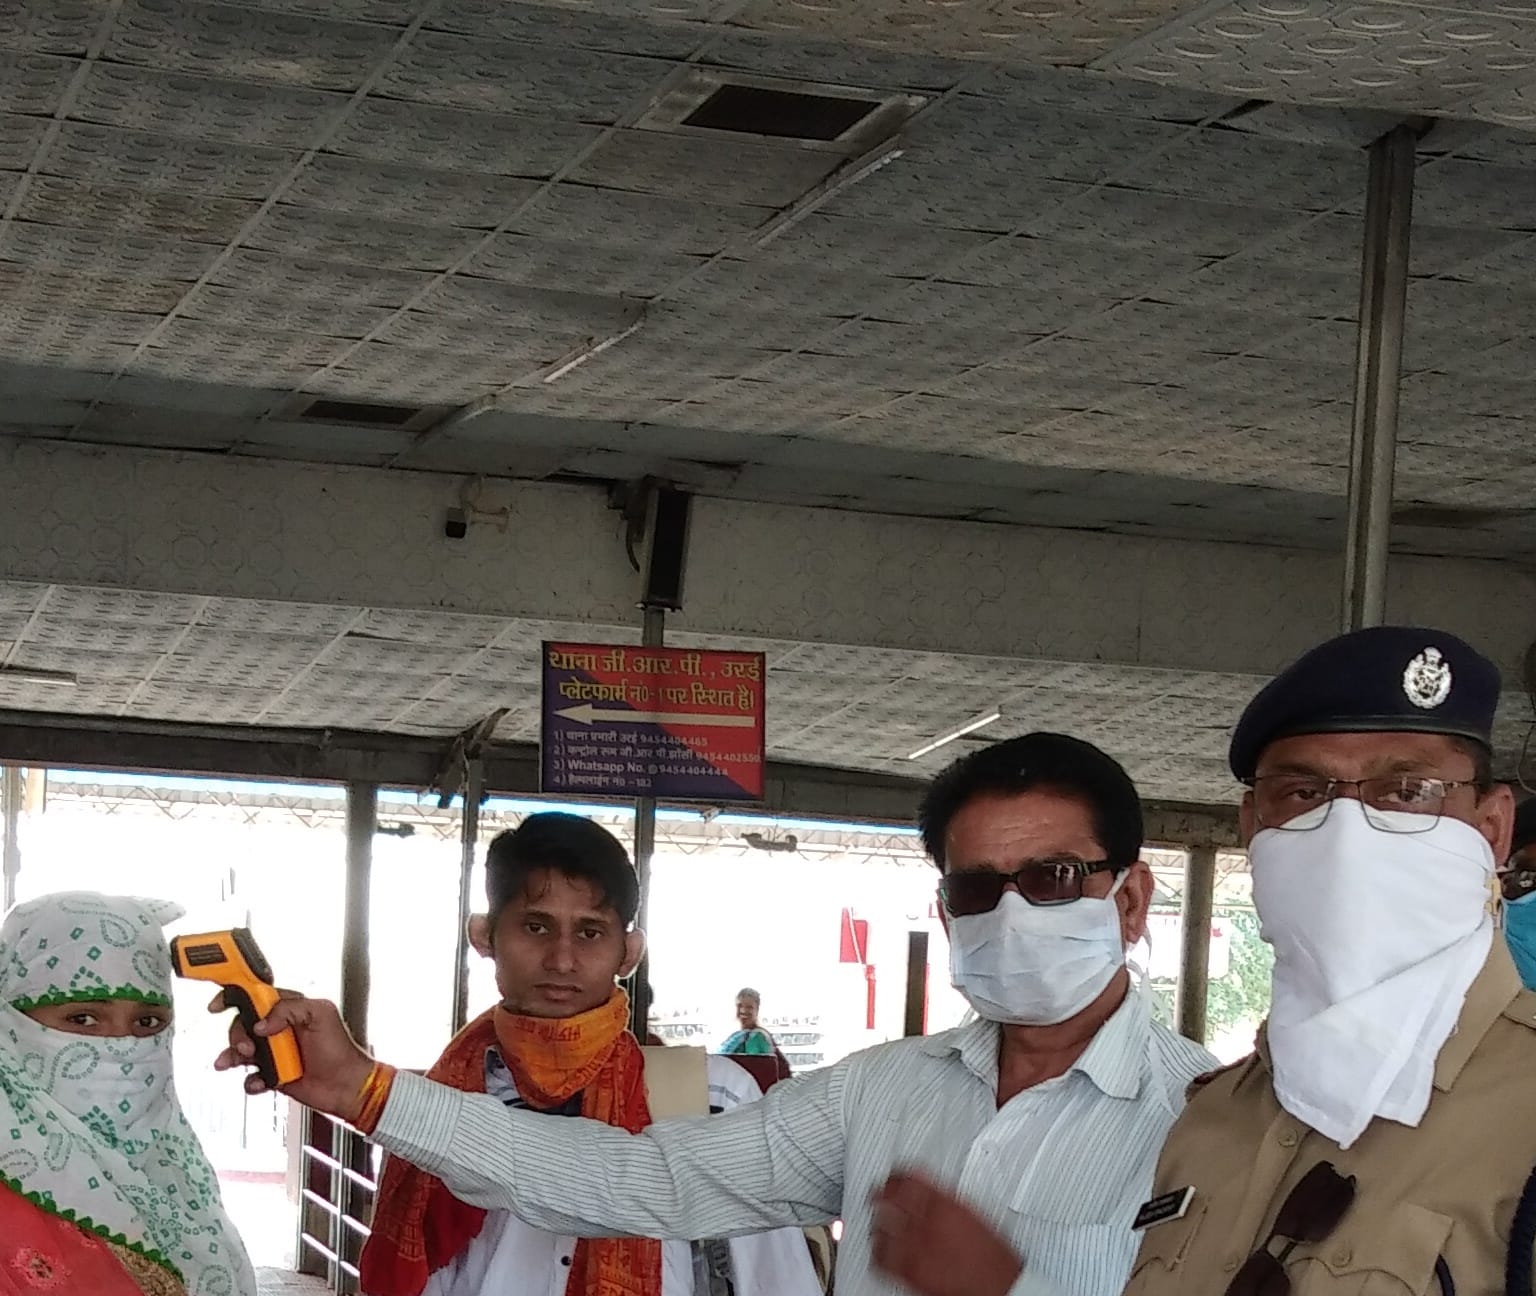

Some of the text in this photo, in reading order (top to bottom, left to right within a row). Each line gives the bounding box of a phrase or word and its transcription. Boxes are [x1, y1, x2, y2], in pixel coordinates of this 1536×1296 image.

[549, 651, 597, 671] थाना
[720, 656, 760, 682] उरई
[567, 760, 624, 773] Whatsapp
